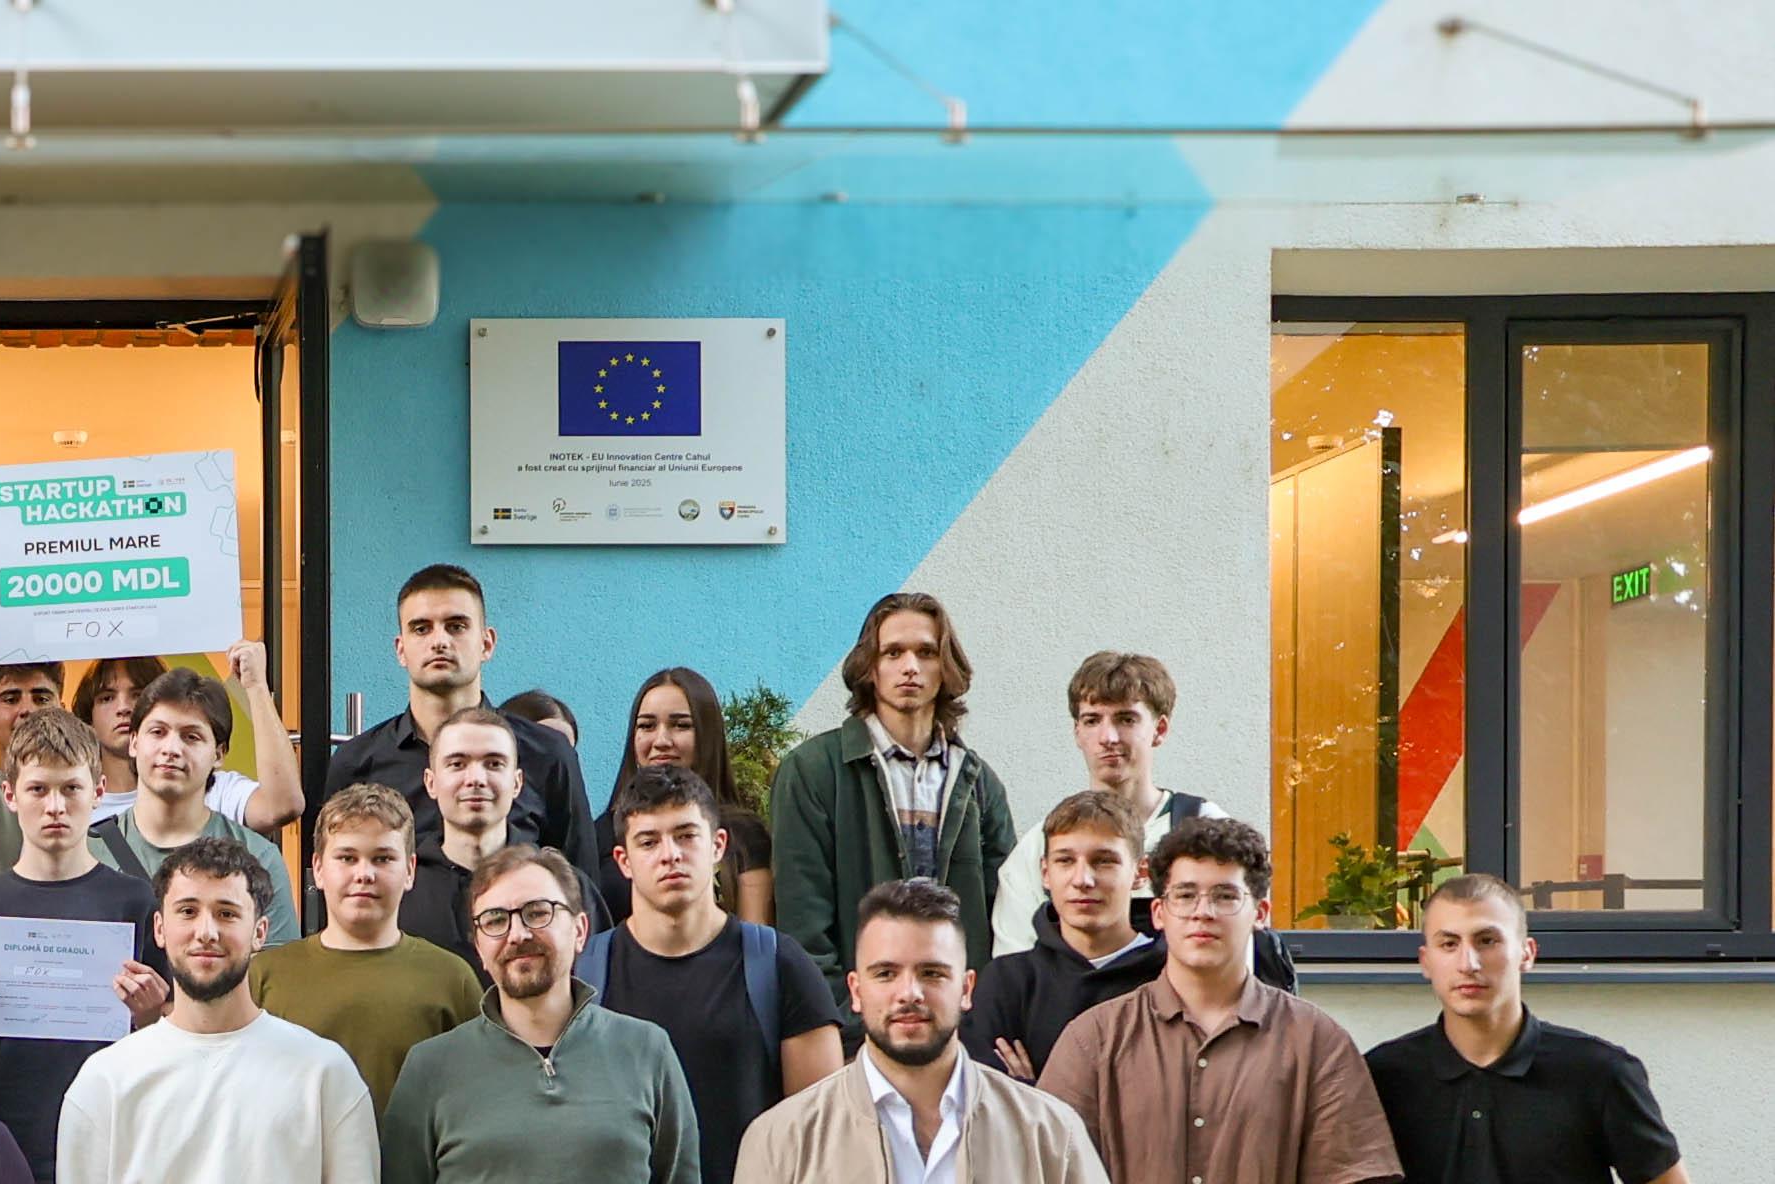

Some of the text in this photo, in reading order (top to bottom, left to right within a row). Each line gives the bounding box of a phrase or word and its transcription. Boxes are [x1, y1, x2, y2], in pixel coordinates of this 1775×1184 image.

[549, 453, 583, 461] INOTEK
[592, 453, 604, 461] EU
[606, 453, 652, 461] Innovation
[654, 453, 683, 461] Centre
[685, 453, 710, 461] Cahul
[525, 464, 541, 472] fost
[544, 464, 566, 472] creat
[581, 464, 616, 474] sprijinul
[618, 464, 656, 472] financiar
[658, 464, 666, 472] al
[668, 464, 699, 472] Uniunii
[701, 464, 743, 474] Europene
[0, 479, 111, 502] STARTUP
[631, 479, 652, 487] 2025
[26, 495, 181, 522] HACKATHON
[24, 534, 161, 556] PREMIUL MARE
[7, 566, 180, 599] 20000 MDL
[1613, 567, 1650, 603] EXIT
[66, 620, 124, 638] FOX
